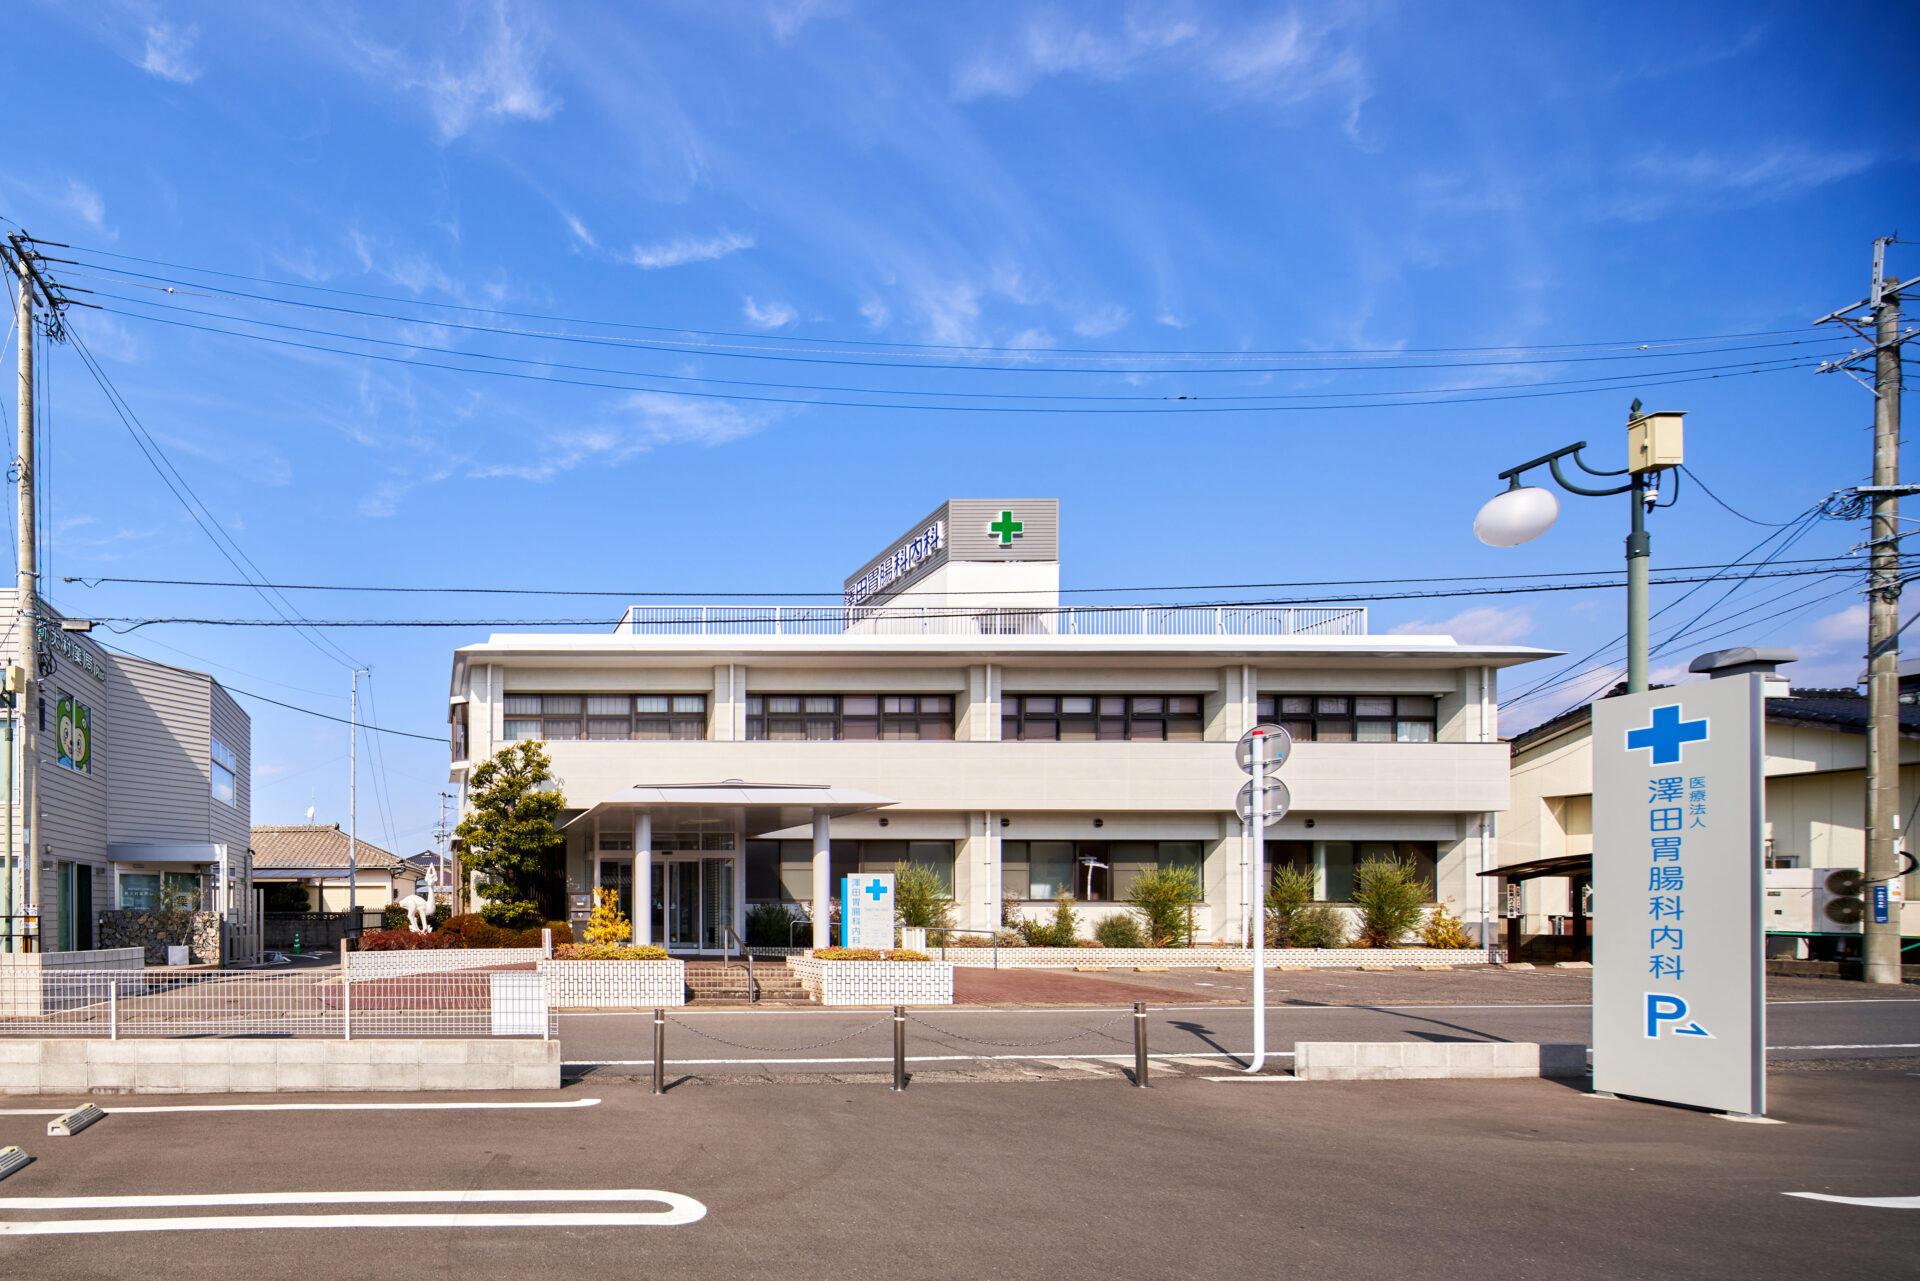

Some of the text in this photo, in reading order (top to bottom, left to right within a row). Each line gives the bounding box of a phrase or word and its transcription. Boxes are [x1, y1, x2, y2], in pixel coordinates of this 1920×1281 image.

[844, 522, 940, 606] 澤田胃腸科内科
[1689, 776, 1706, 829] 医療法人
[1648, 776, 1685, 981] 澤田胃腸科内科
[1646, 994, 1688, 1038] P
